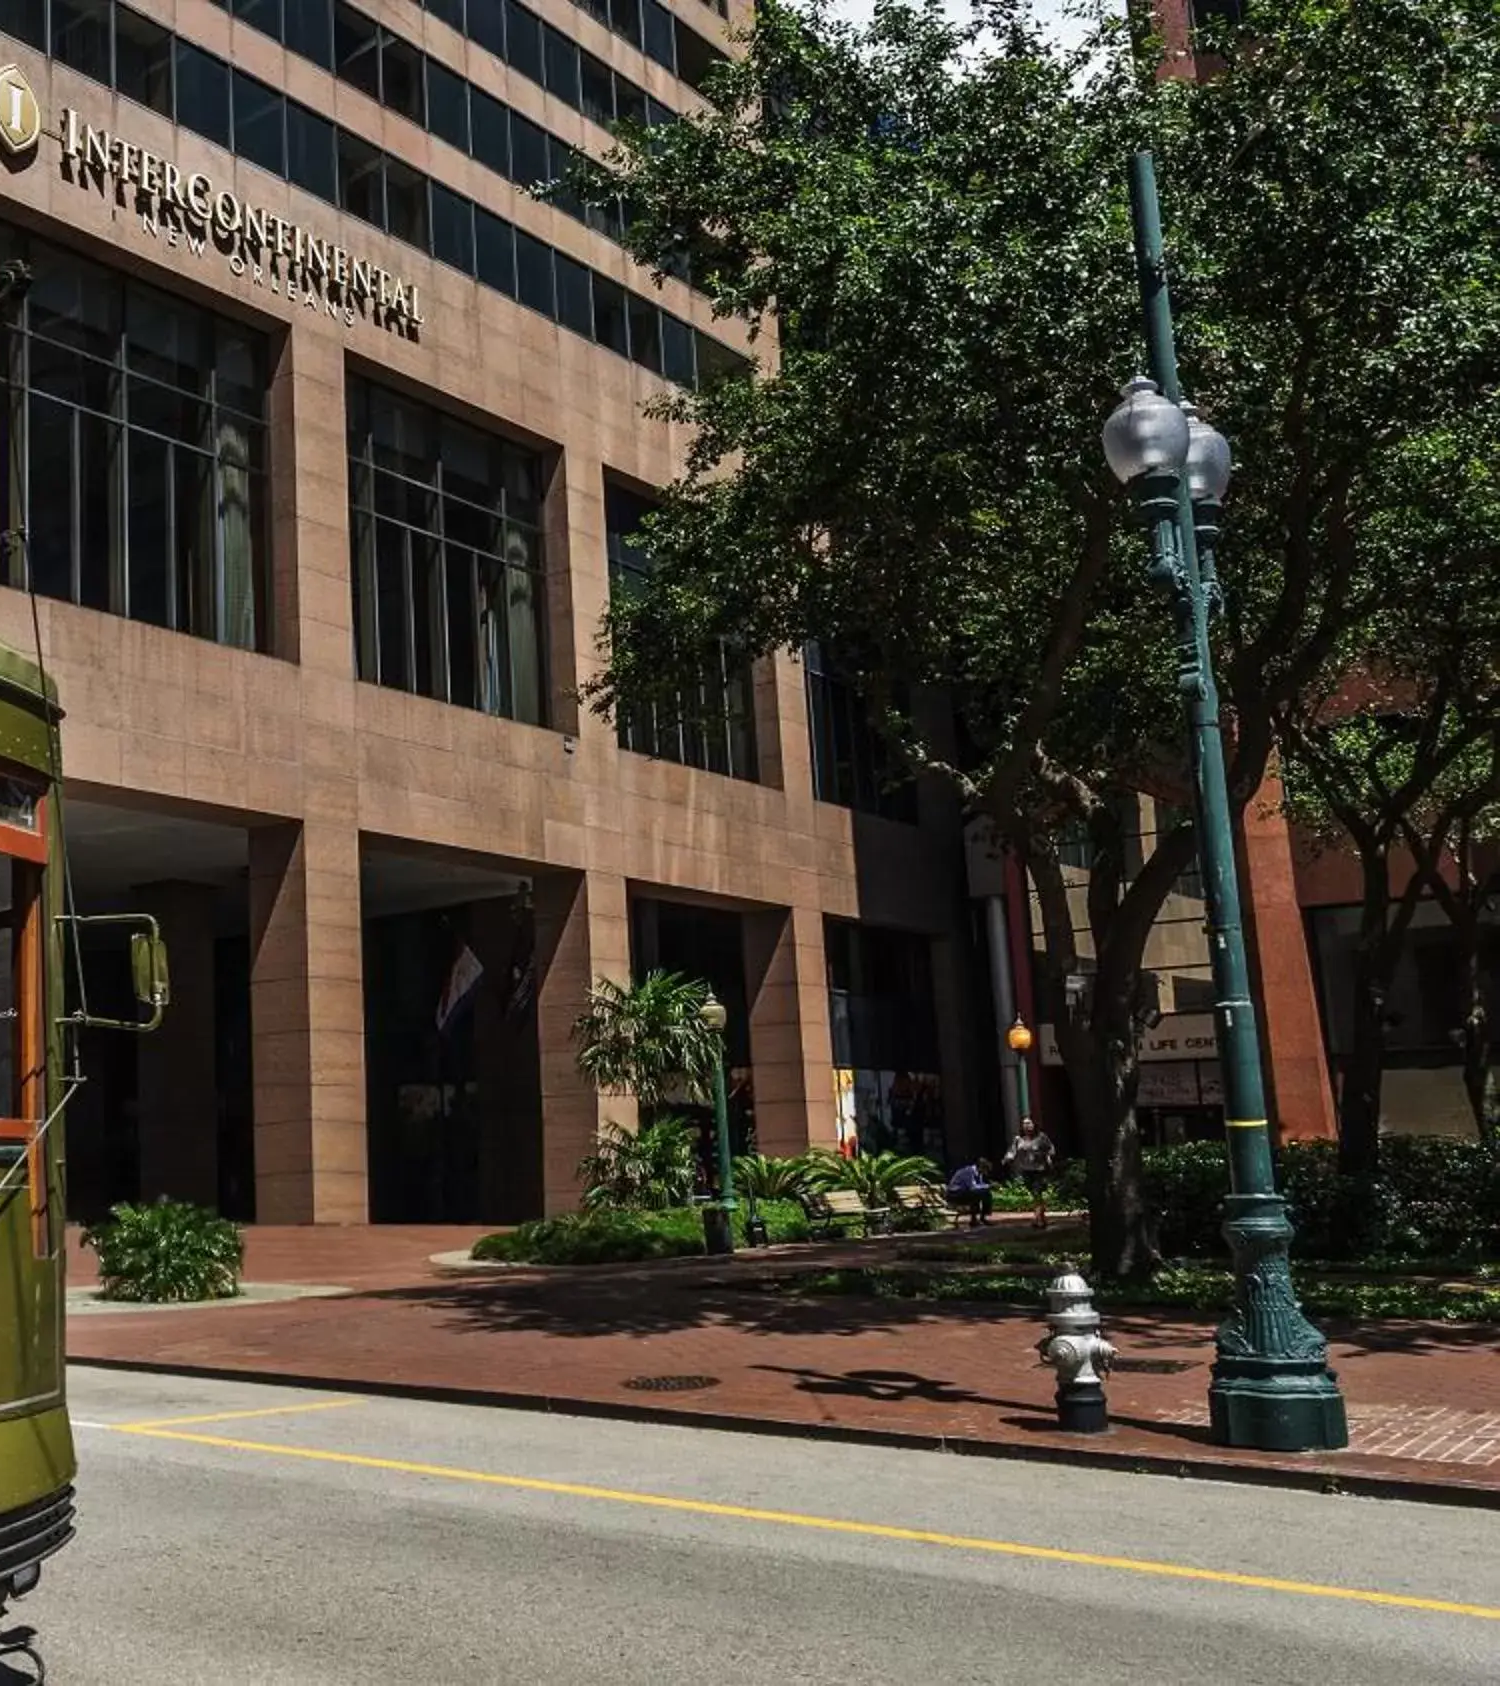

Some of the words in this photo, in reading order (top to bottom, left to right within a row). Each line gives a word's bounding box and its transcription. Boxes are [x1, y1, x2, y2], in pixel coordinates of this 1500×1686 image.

[64, 107, 424, 324] INTERCONTINENTAL
[143, 214, 206, 259] NEW
[229, 255, 357, 328] ORLEANS
[1150, 1039, 1178, 1052] LIFE
